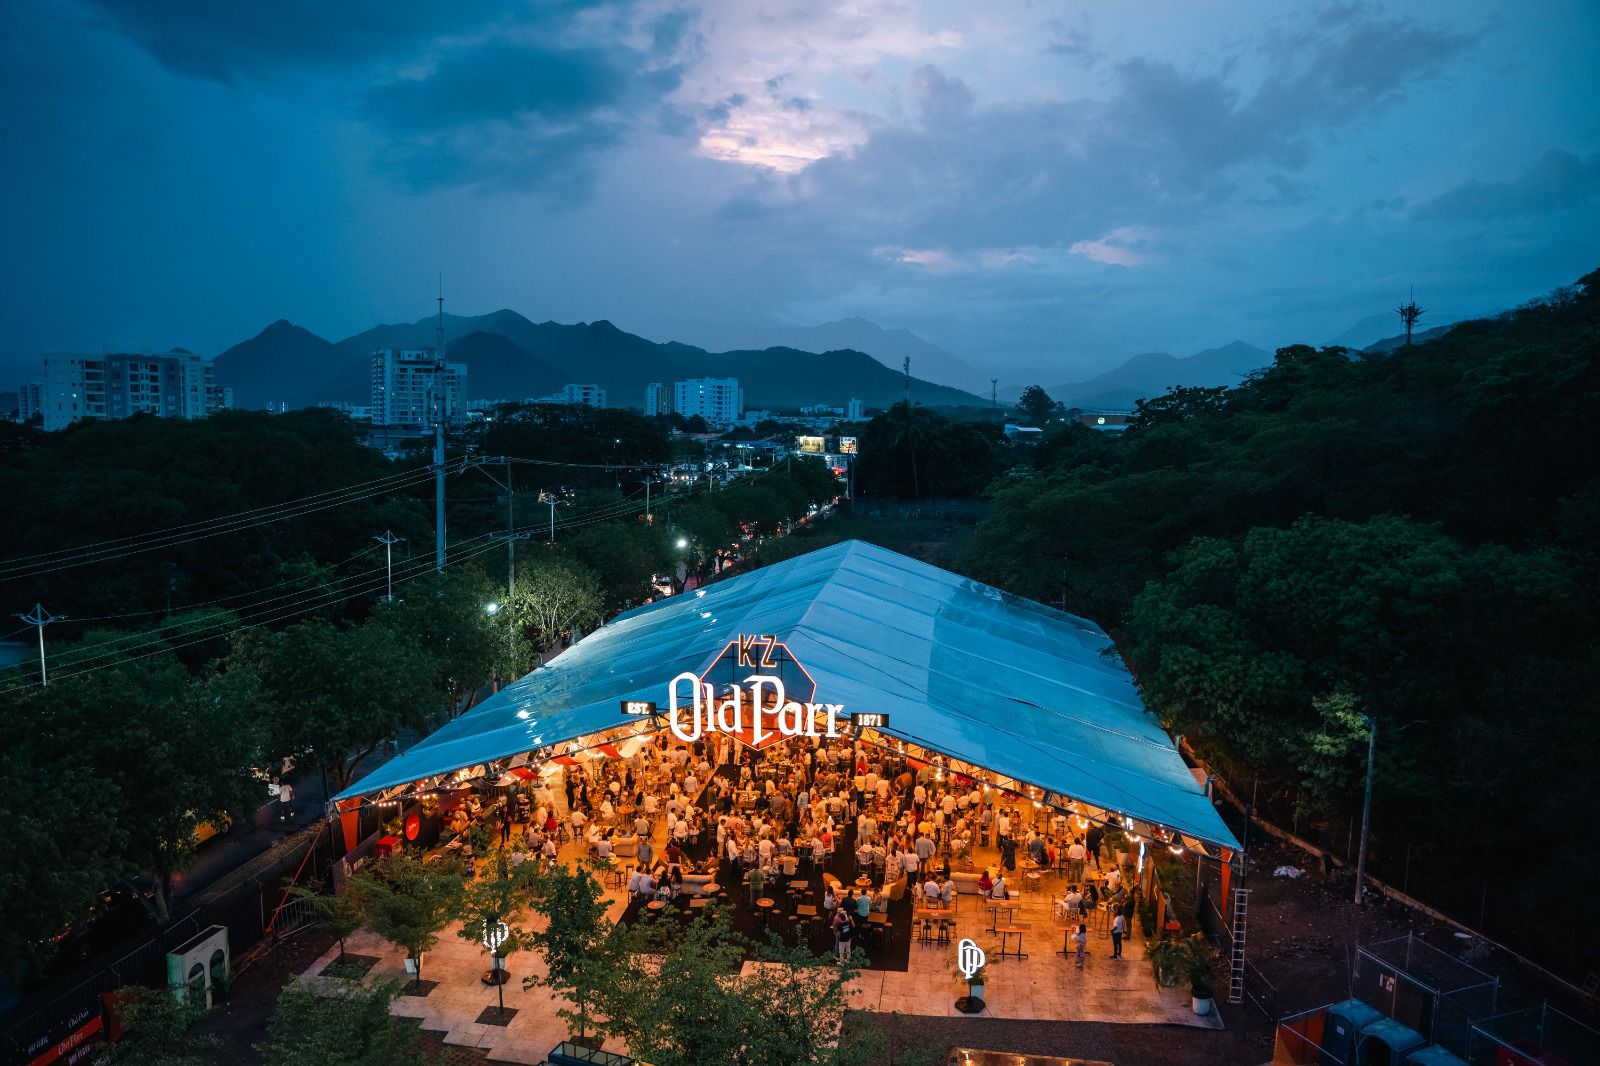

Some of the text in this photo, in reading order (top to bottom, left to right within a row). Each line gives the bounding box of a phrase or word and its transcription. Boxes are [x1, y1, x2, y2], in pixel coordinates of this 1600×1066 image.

[739, 634, 777, 667] KZ
[627, 703, 650, 714] EST.
[669, 672, 844, 745] Old Parr
[858, 713, 882, 726] 1871
